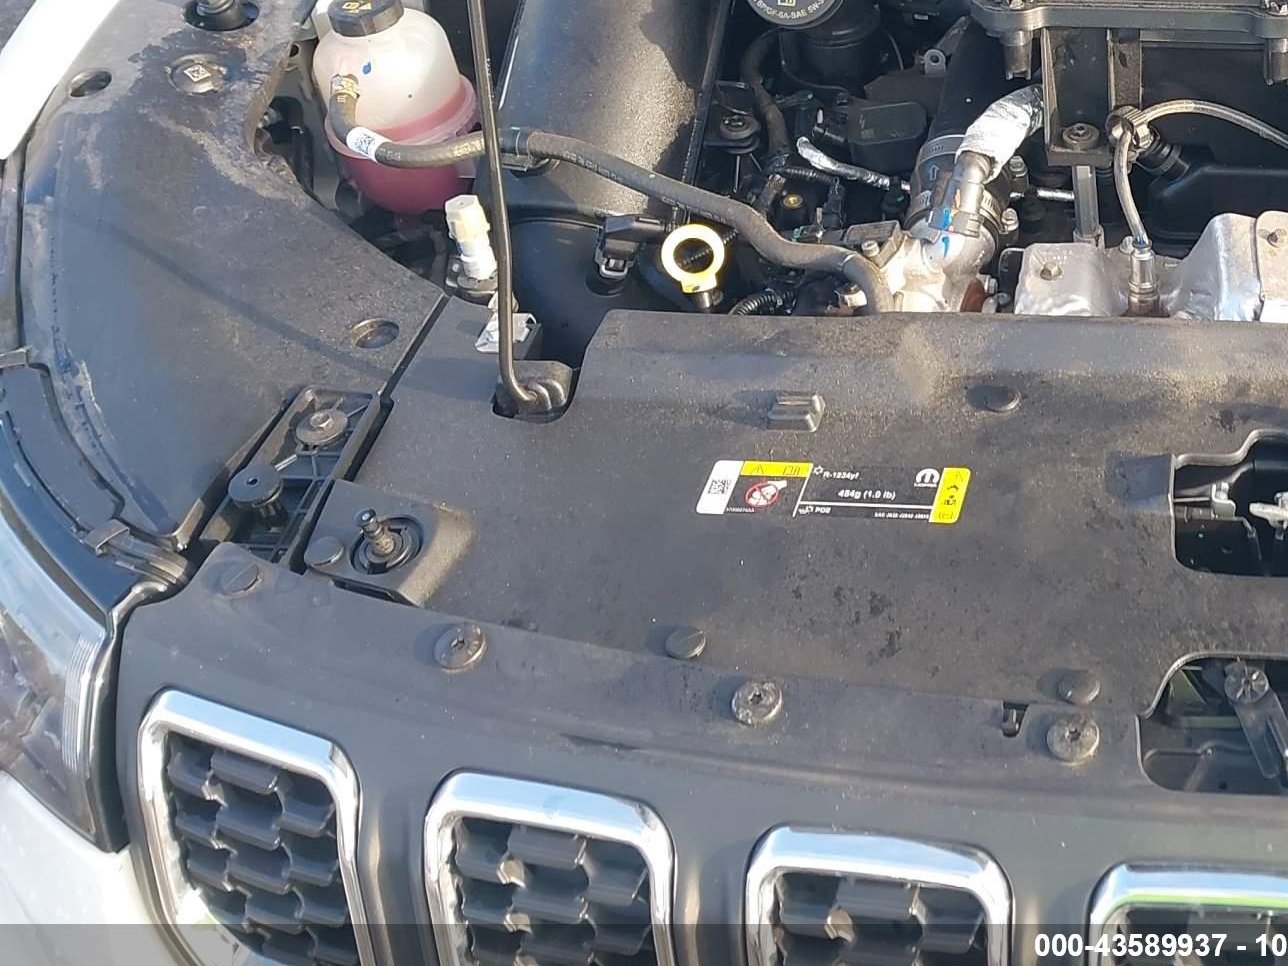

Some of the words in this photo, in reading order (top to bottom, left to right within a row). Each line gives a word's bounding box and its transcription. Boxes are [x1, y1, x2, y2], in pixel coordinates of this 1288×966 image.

[823, 471, 860, 480] R-1234yf
[863, 490, 881, 500] (1.0
[882, 490, 896, 501] lb)
